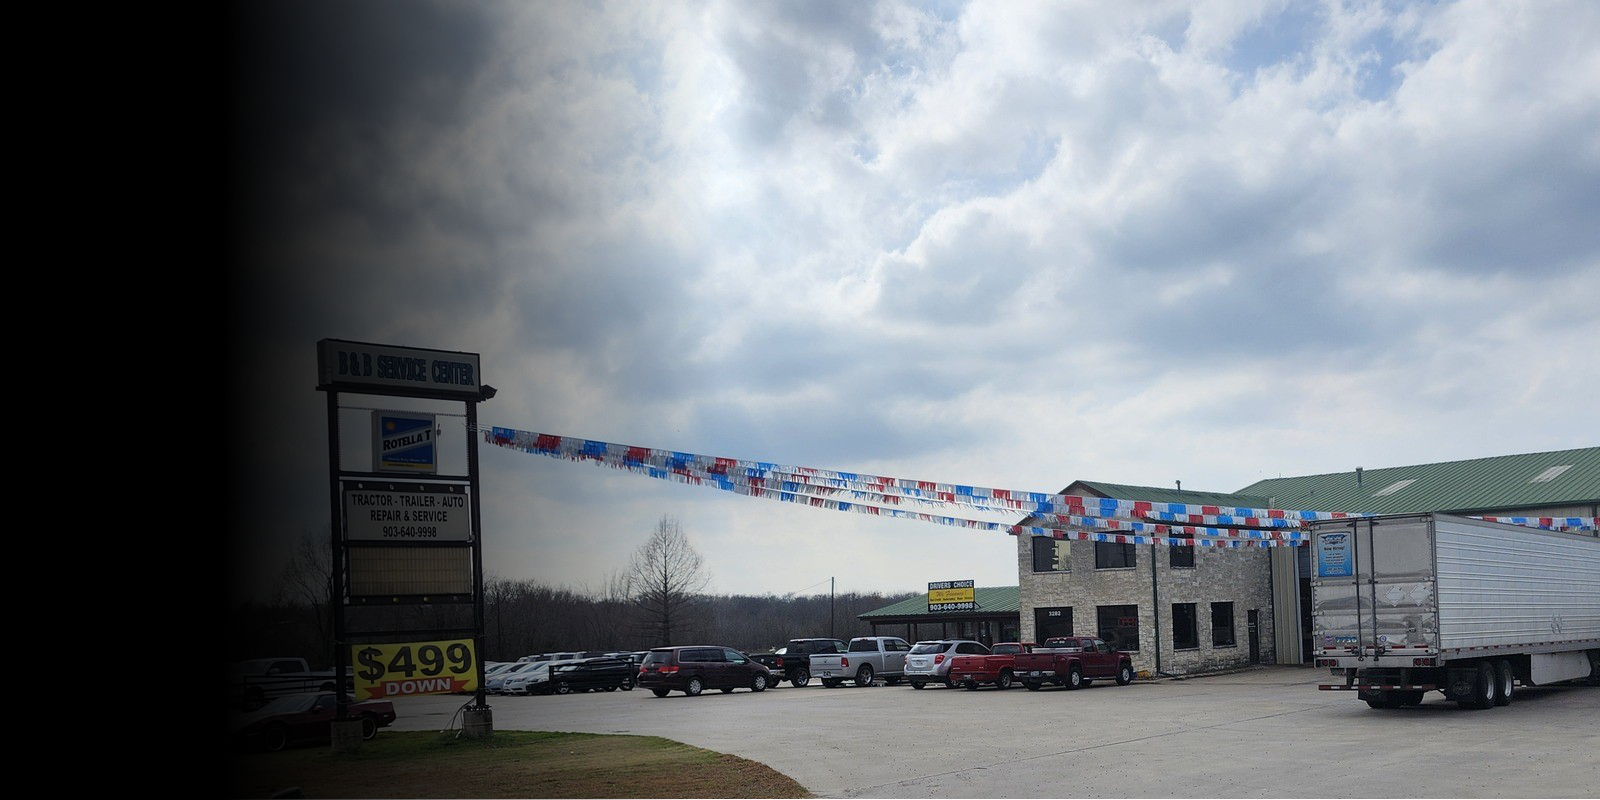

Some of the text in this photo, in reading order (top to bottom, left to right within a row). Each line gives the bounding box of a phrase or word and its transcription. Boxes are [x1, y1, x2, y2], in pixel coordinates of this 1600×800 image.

[338, 351, 475, 386] B & B SERVICE CENTER
[383, 429, 431, 451] ROTELLA T
[351, 494, 393, 506] TRACTOR
[400, 495, 435, 507] TRAILER
[442, 496, 464, 508] AUTO
[370, 510, 448, 522] REPAIR & SERVICE
[383, 526, 437, 538] 903-640-9998
[930, 580, 974, 590] DRIVERS CHOICE
[930, 602, 974, 611] 903-640-9998
[357, 643, 472, 685] $499
[385, 678, 451, 696] DOWN
